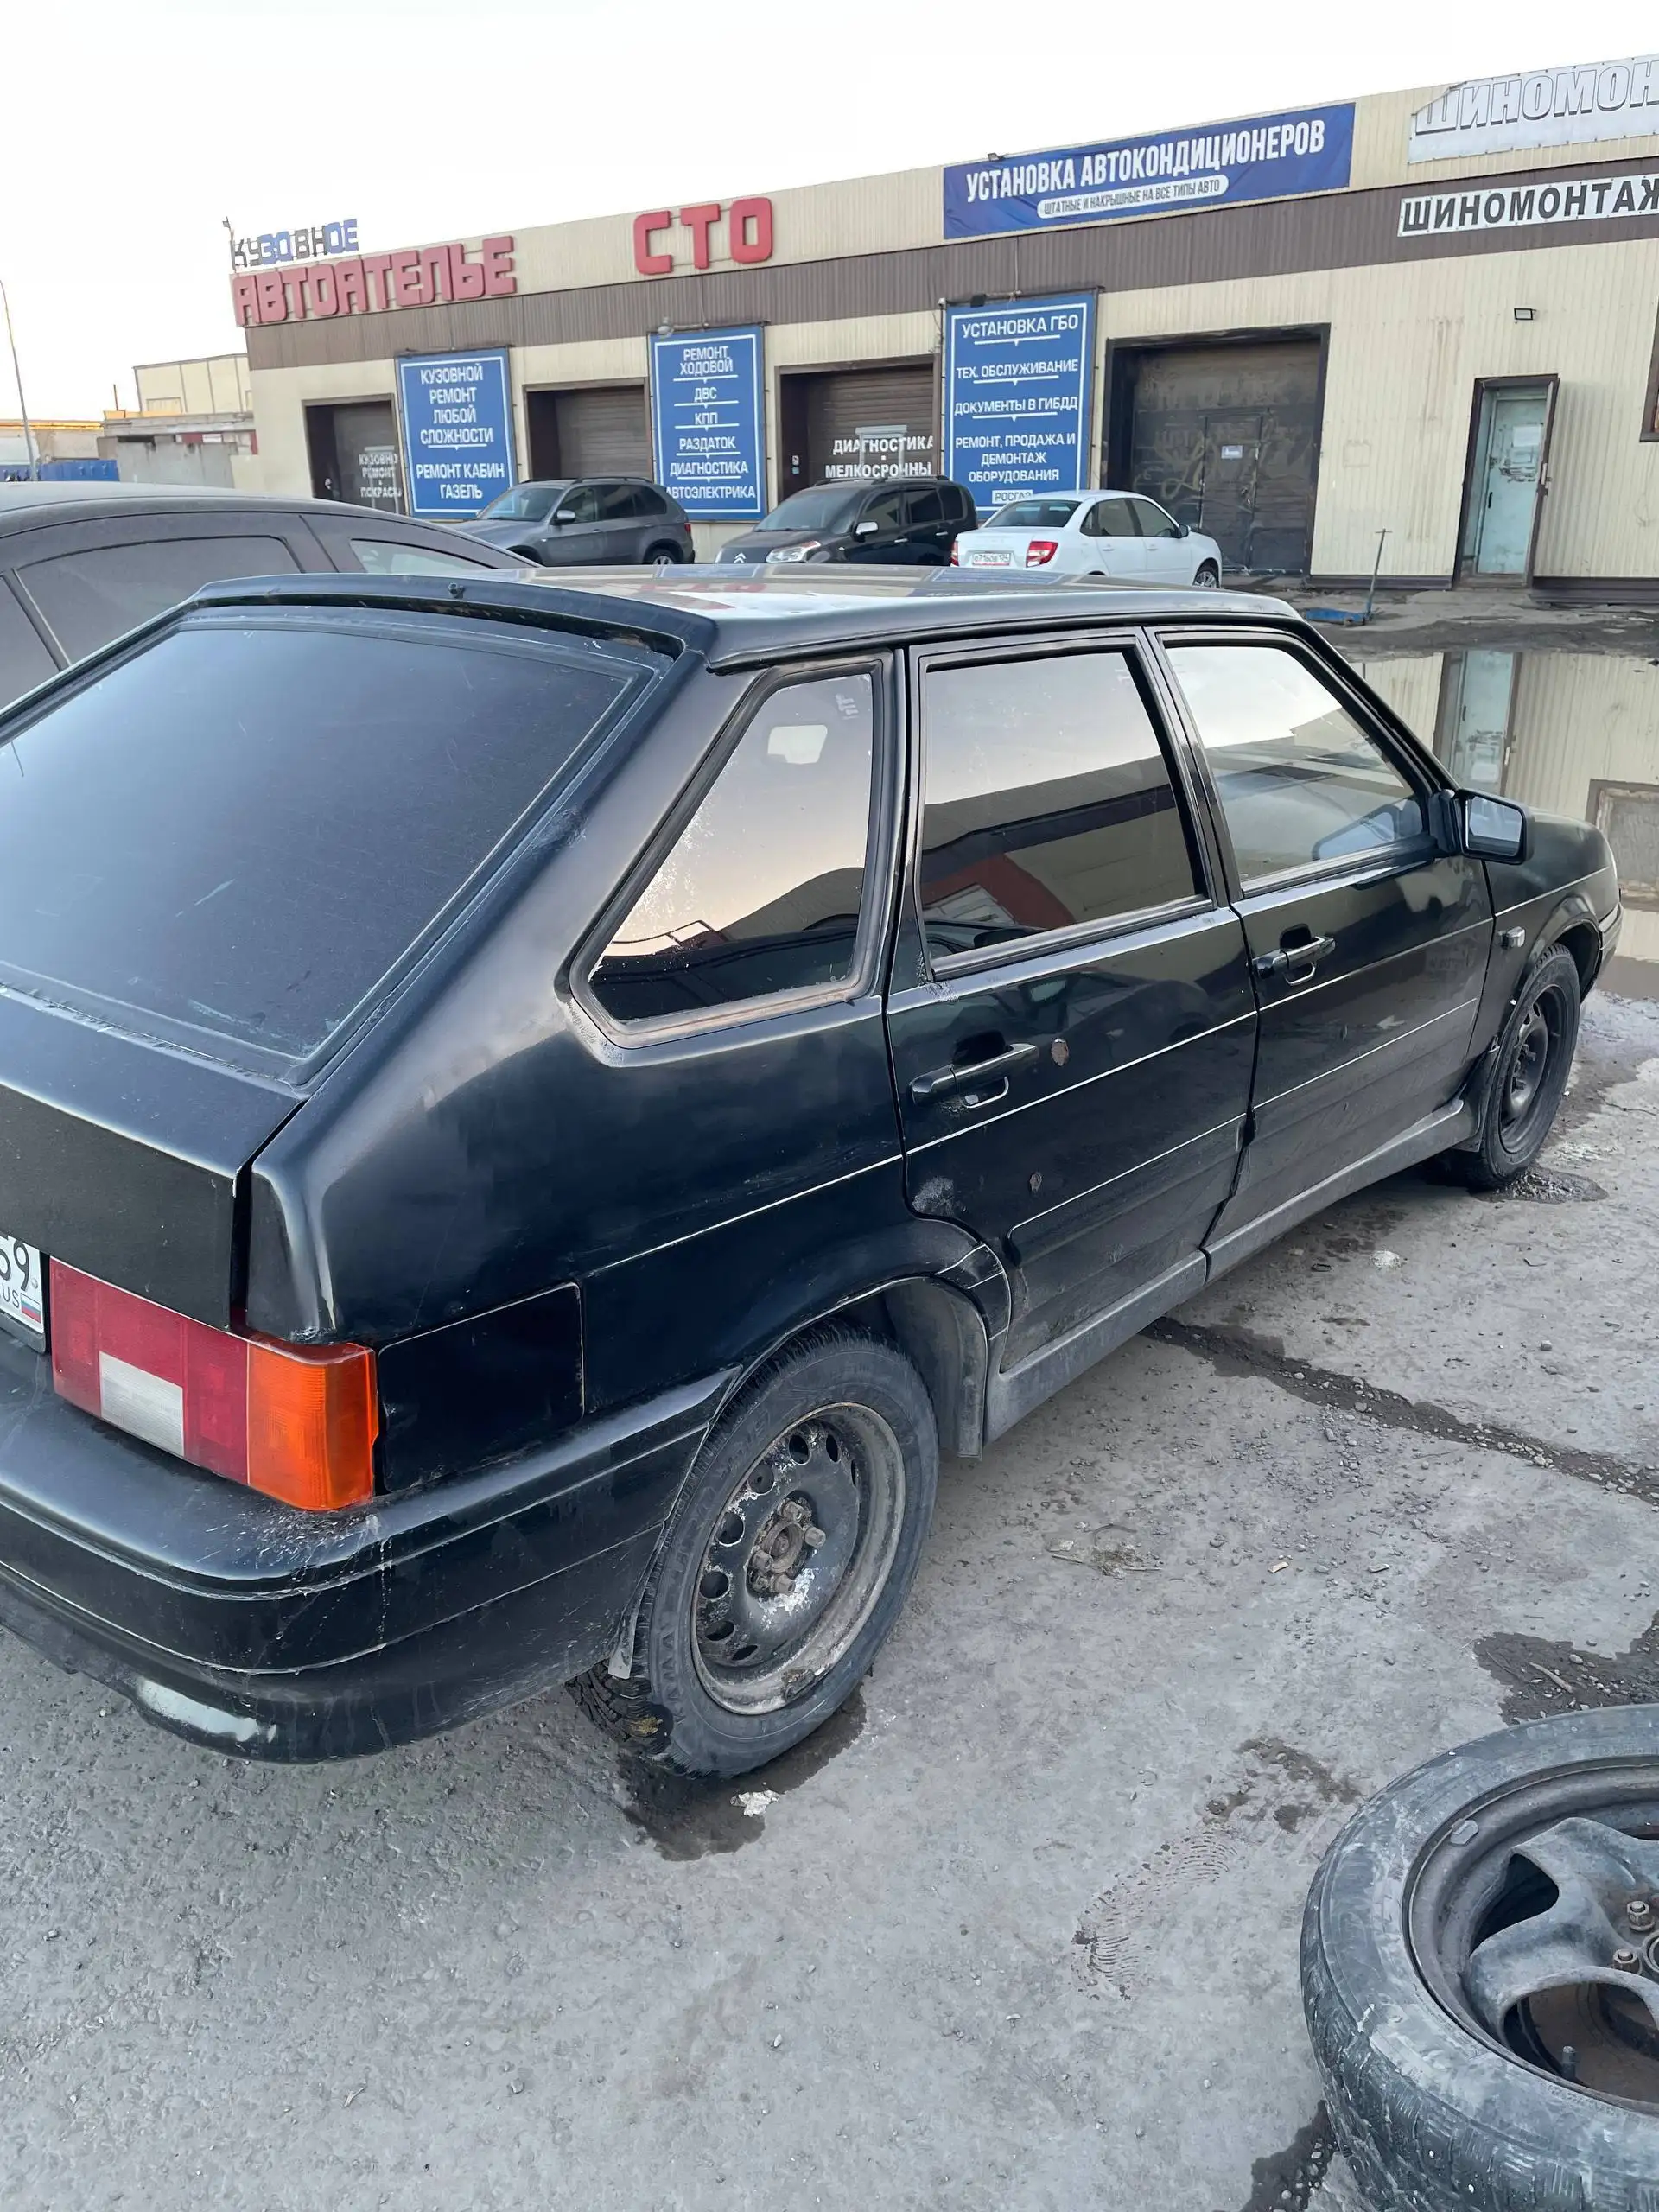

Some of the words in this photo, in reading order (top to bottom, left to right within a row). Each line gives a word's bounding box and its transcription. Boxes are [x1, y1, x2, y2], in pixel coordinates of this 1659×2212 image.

[966, 159, 1076, 203] УСТАНОВКА
[1081, 119, 1325, 188] АВТОКОНДИЦИОНЕРОВ
[1044, 198, 1082, 215] ШТАТНЫЕ
[1083, 198, 1090, 210] И
[1090, 190, 1141, 208] НАКРЫШНЫЕ
[1142, 188, 1154, 201] НА
[1155, 186, 1172, 200] ВСЕ
[1173, 182, 1197, 197] ТИПЫ
[1198, 179, 1221, 195] АВТО
[1402, 178, 1659, 232] ШИНОМОНТАЖ
[231, 219, 359, 268] КУЗОВНОЕ
[633, 197, 773, 275] СТО
[233, 235, 517, 326] АВТОАТЕЛЬЕ
[963, 320, 1046, 339] УСТАНОВКА
[1051, 315, 1078, 331] ГБО
[683, 346, 728, 362] РЕМОНТ
[420, 363, 484, 385] КУЗОВНОЙ
[680, 357, 734, 377] ХОДОВОЙ
[957, 366, 978, 379] ТЕХ.
[981, 359, 1078, 378] ОБСЛУЖИВАНИЕ
[429, 387, 477, 404] РЕМОНТ
[694, 387, 717, 403] ДВС
[433, 405, 476, 424] ЛЮБОЙ
[954, 399, 1026, 416] ДОКУМЕНТЫ
[1028, 398, 1036, 410] В
[1039, 396, 1077, 411] ГИБДД
[695, 412, 718, 424] КПП
[420, 427, 494, 444] СЛОЖНОСТИ
[679, 436, 736, 452] РАЗДАТОК
[833, 435, 933, 455] ДИАГНОСТИКА
[956, 435, 1002, 449] РЕМОНТ,
[1005, 433, 1064, 448] ПРОДАЖА
[1066, 433, 1076, 445] И
[670, 461, 749, 476] ДИАГНОСТИКА
[981, 452, 1047, 467] ДЕМОНТАЖ
[416, 464, 461, 479] РЕМОНТ
[463, 463, 505, 478] КАБИН
[969, 469, 1059, 484] ОБОРУДОВАНИЯ
[440, 484, 483, 499] ГАЗЕЛЬ
[666, 486, 756, 499] АВТОЭЛЕКТРИКА
[0, 1282, 20, 1309] US
